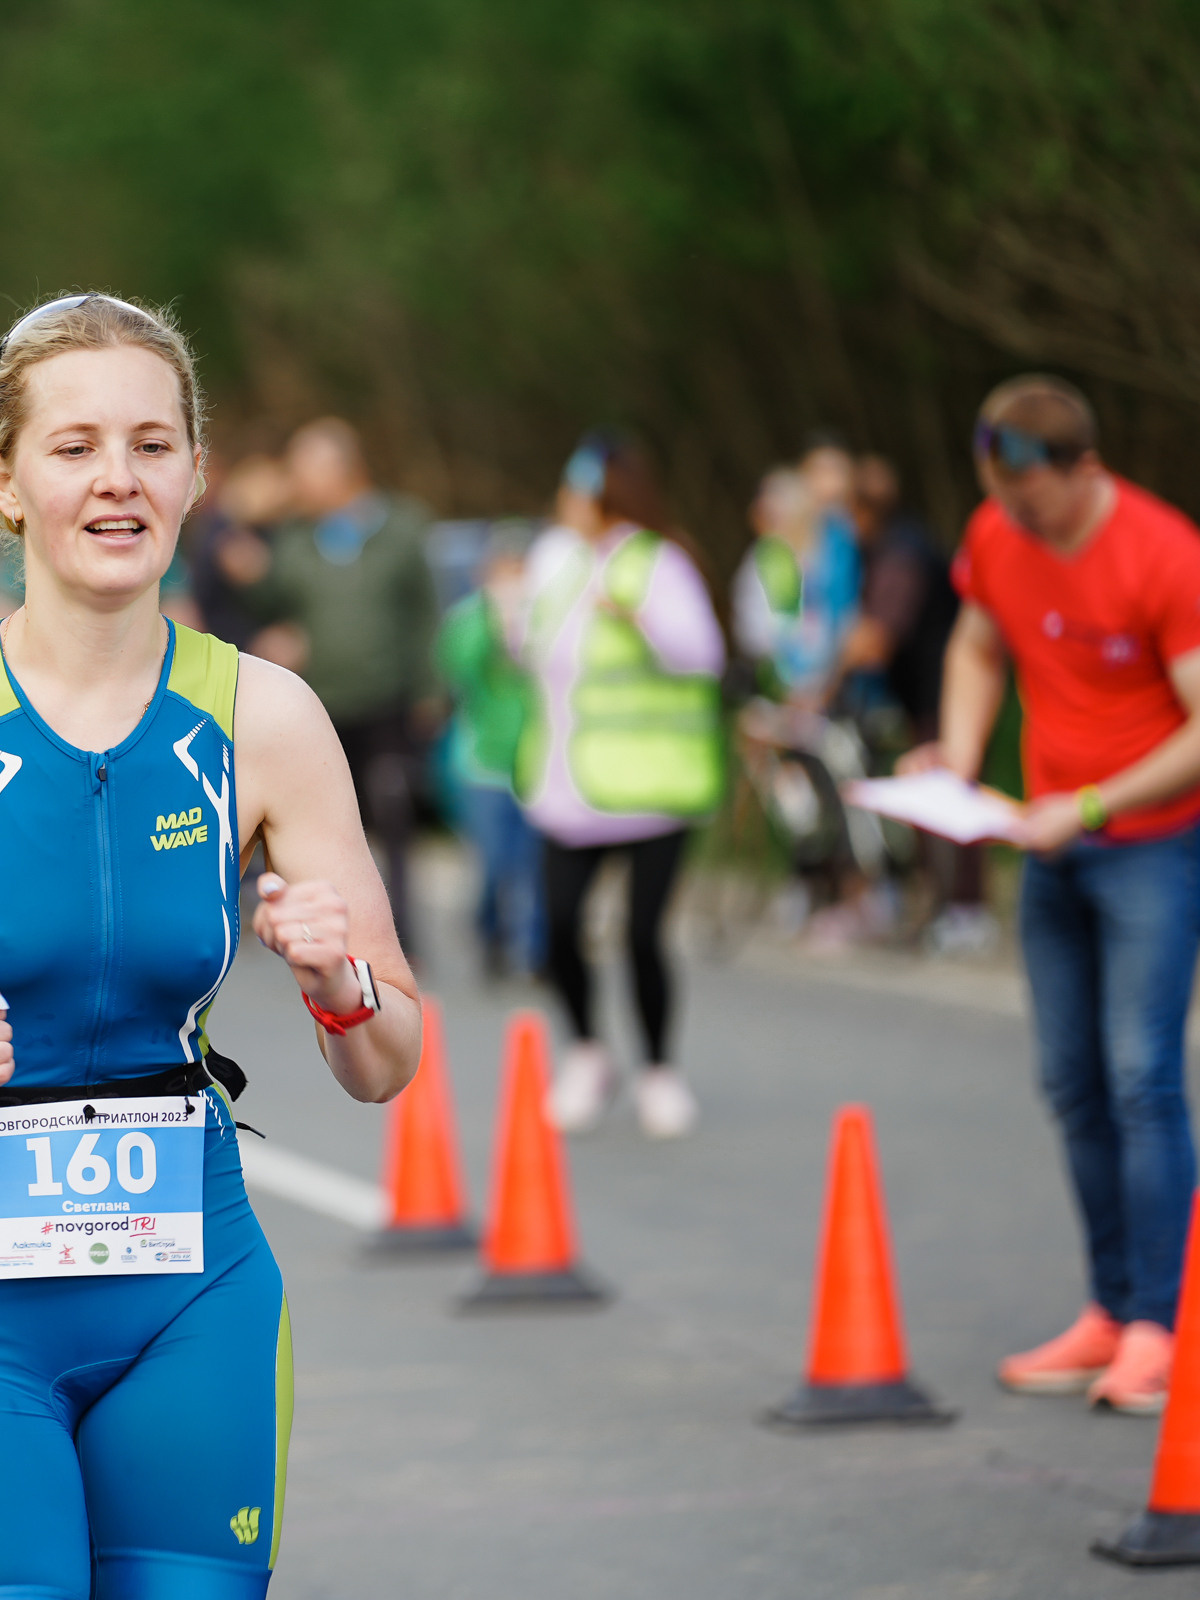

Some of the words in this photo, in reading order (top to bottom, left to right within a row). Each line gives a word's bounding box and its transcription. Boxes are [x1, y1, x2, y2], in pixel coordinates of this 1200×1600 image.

[156, 807, 202, 832] MAD
[150, 825, 208, 851] WAVE
[96, 1112, 159, 1125] ТРИАТЛОН
[161, 1112, 189, 1123] 2023
[26, 1132, 157, 1197] 160
[62, 1200, 131, 1213] Светлана
